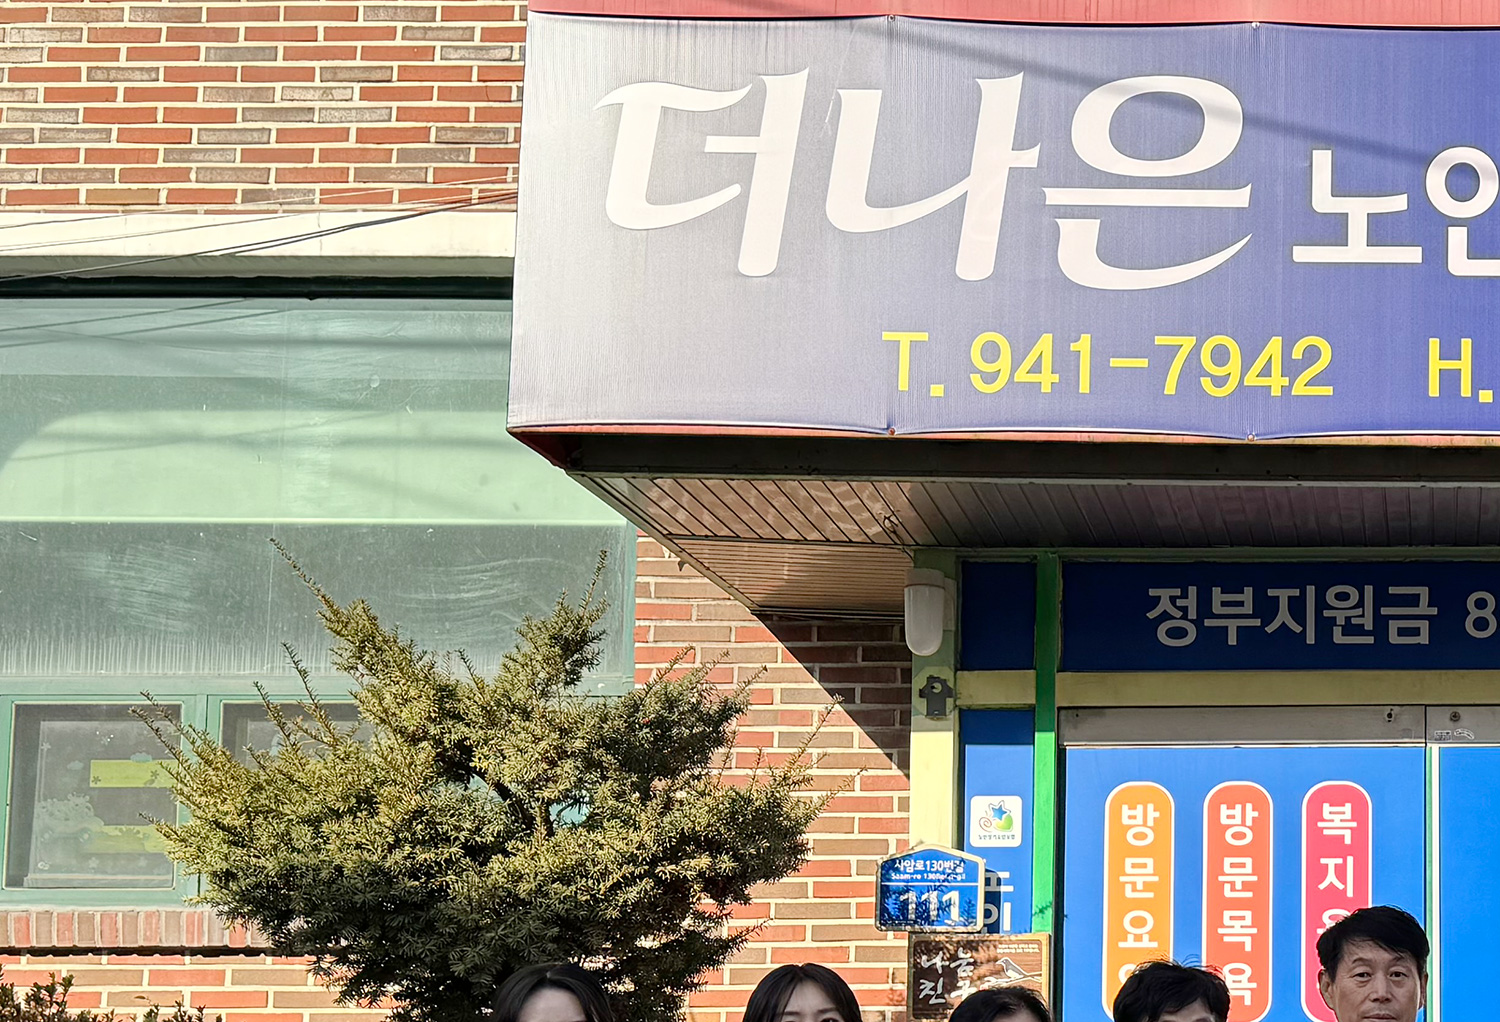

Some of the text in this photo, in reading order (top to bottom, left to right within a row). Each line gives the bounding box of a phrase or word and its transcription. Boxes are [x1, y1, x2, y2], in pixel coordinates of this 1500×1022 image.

[595, 67, 1253, 291] 더나은
[882, 332, 945, 399] T.
[969, 332, 1335, 399] 941-7942
[1427, 337, 1493, 404] H.
[1146, 584, 1439, 648] 정부지원금
[1217, 802, 1260, 1006] 방문목욕
